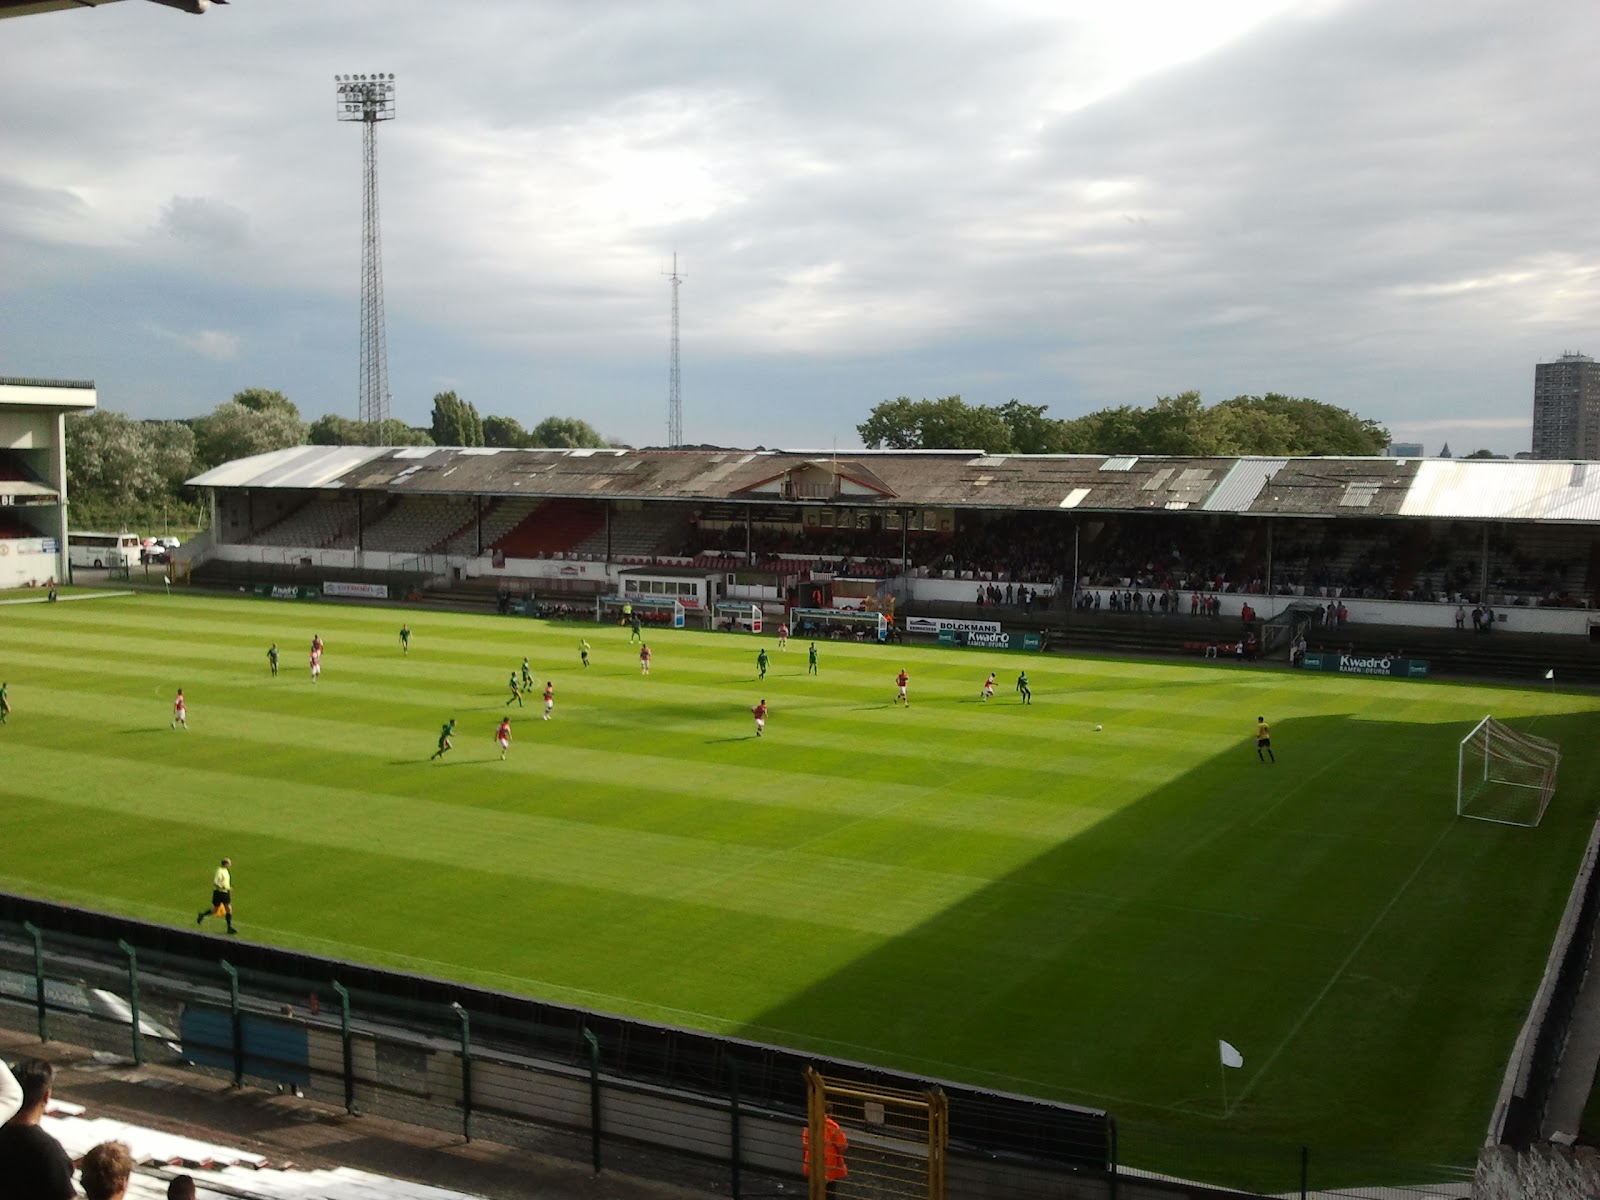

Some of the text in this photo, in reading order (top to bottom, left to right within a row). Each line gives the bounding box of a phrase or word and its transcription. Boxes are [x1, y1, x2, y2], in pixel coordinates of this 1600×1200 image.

[940, 622, 998, 632] BOLCKMANS
[1339, 665, 1391, 675] RAMEN DEUREN
